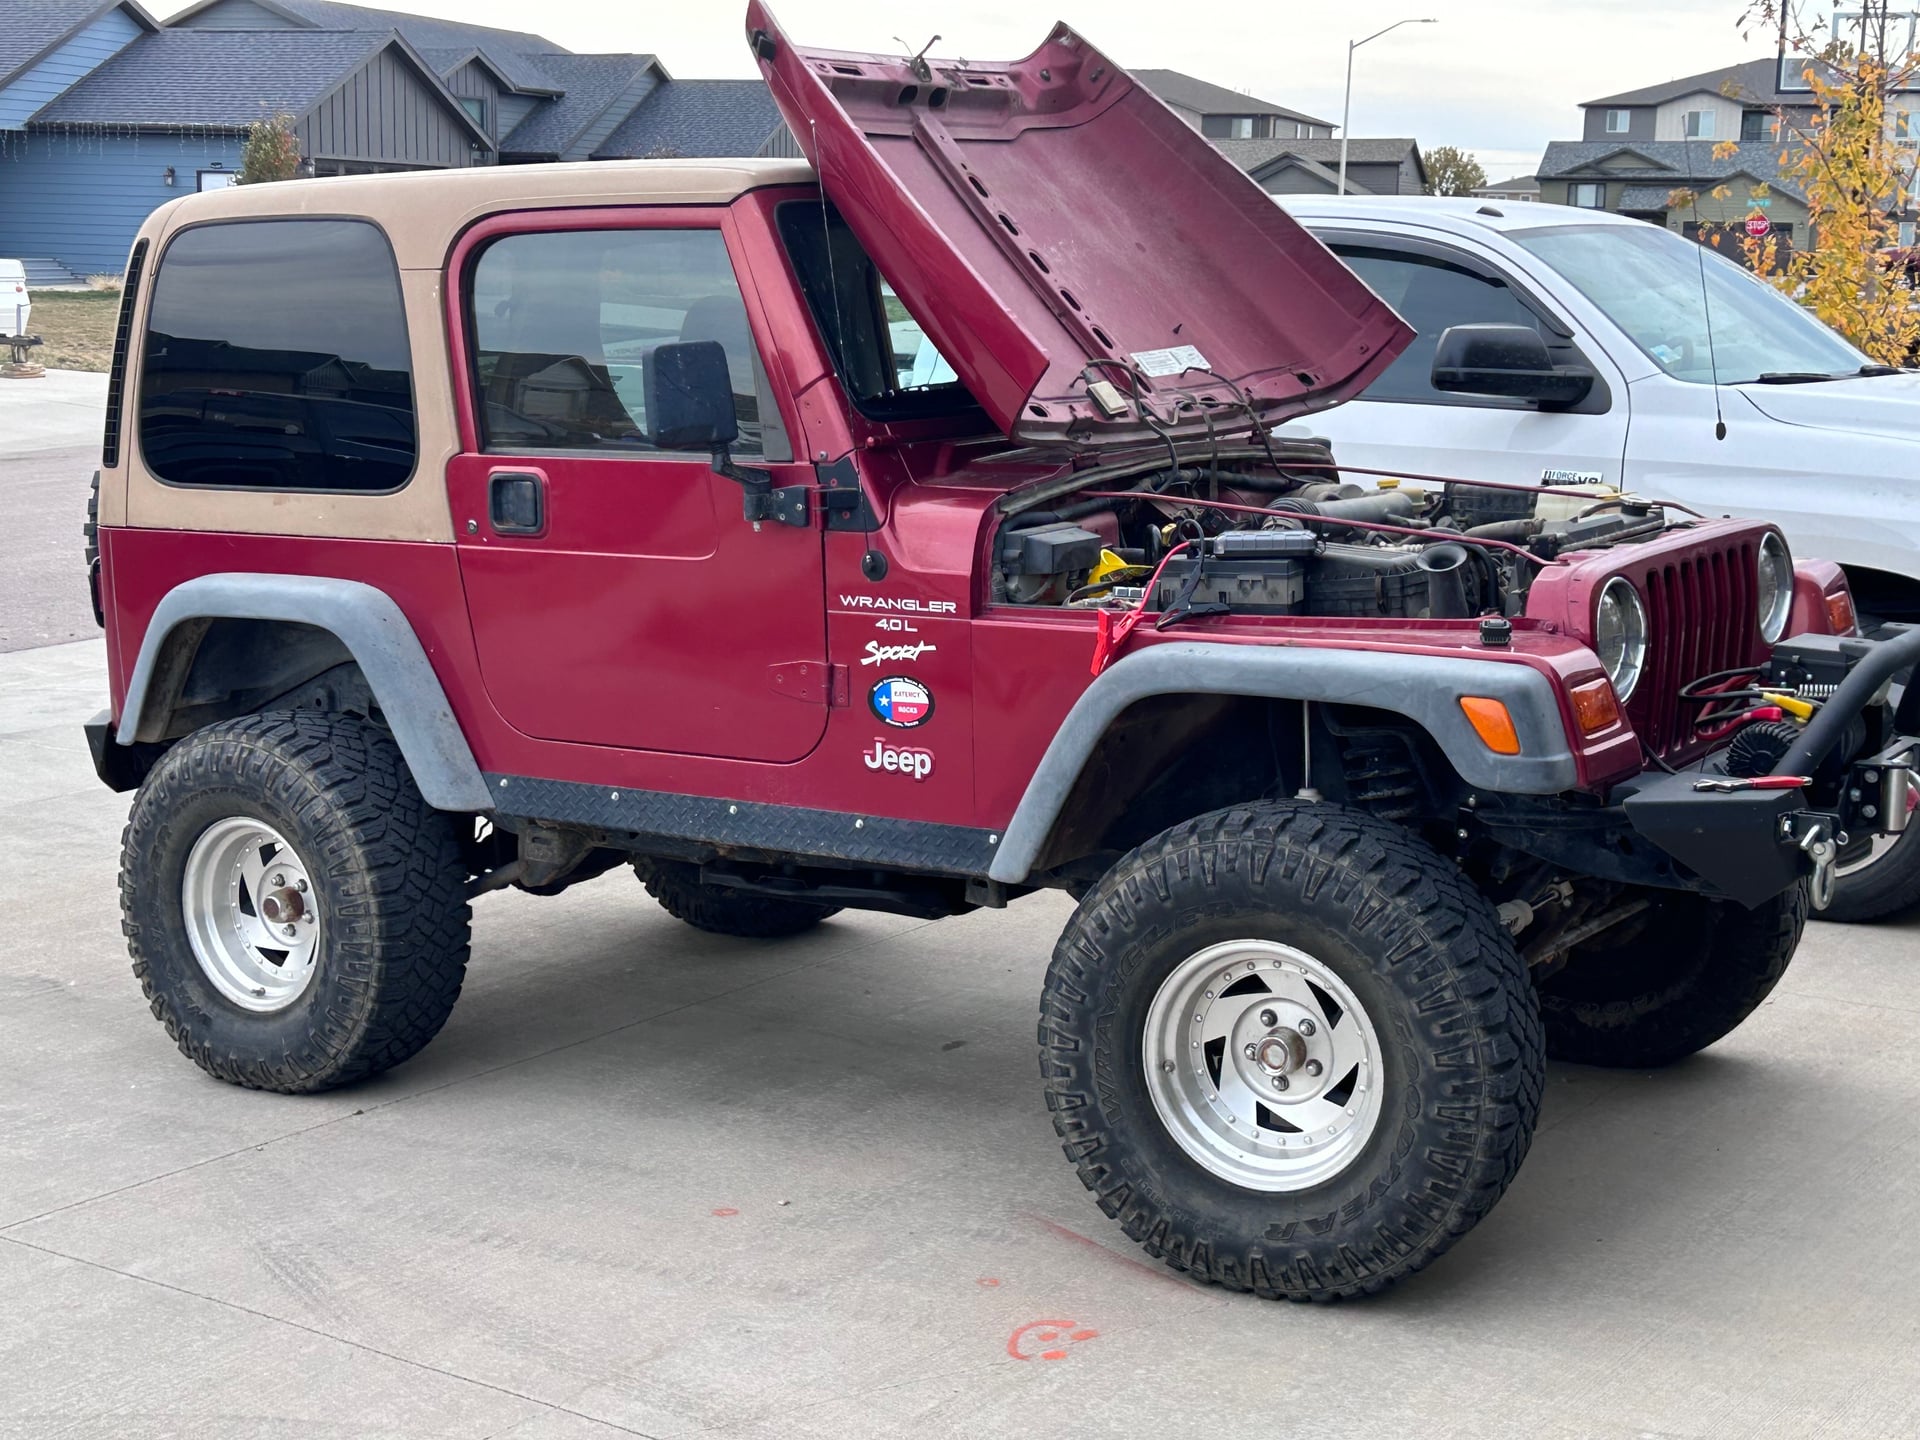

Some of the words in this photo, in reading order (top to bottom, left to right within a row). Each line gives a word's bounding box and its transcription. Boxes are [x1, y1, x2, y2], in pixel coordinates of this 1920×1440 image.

[1747, 220, 1769, 230] STOP
[839, 594, 957, 613] WRANGLER
[860, 640, 937, 667] Sport
[863, 738, 933, 779] Jeep
